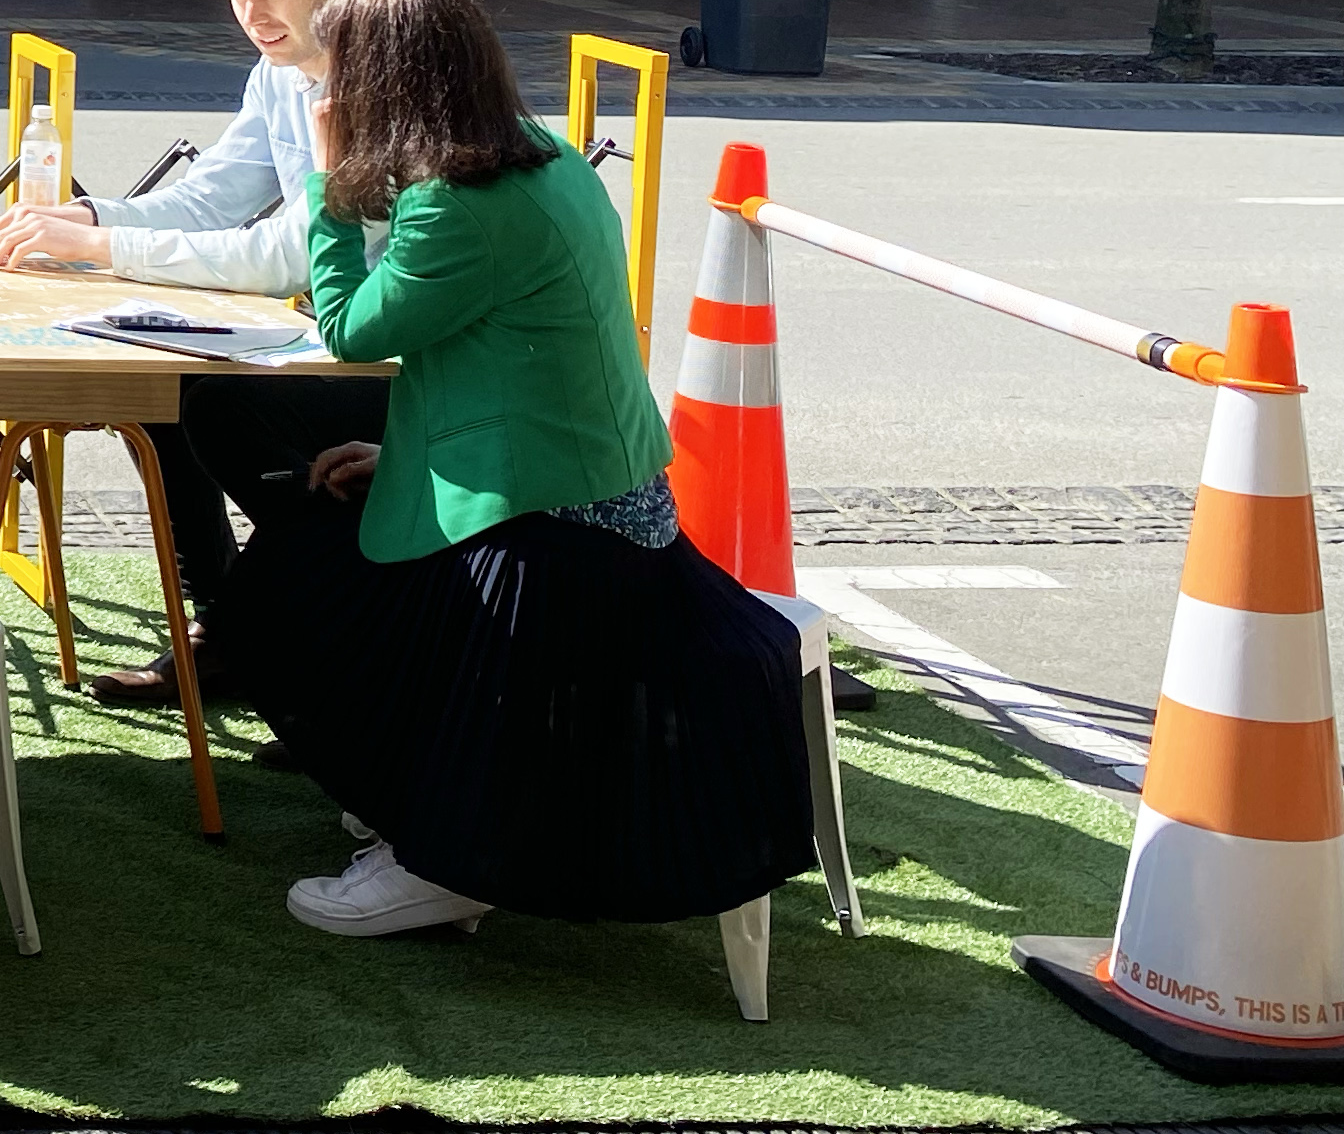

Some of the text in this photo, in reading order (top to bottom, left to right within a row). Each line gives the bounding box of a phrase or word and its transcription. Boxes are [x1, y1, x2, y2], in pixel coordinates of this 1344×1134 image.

[1130, 961, 1328, 1024] & BUMPS, THIS IS A
